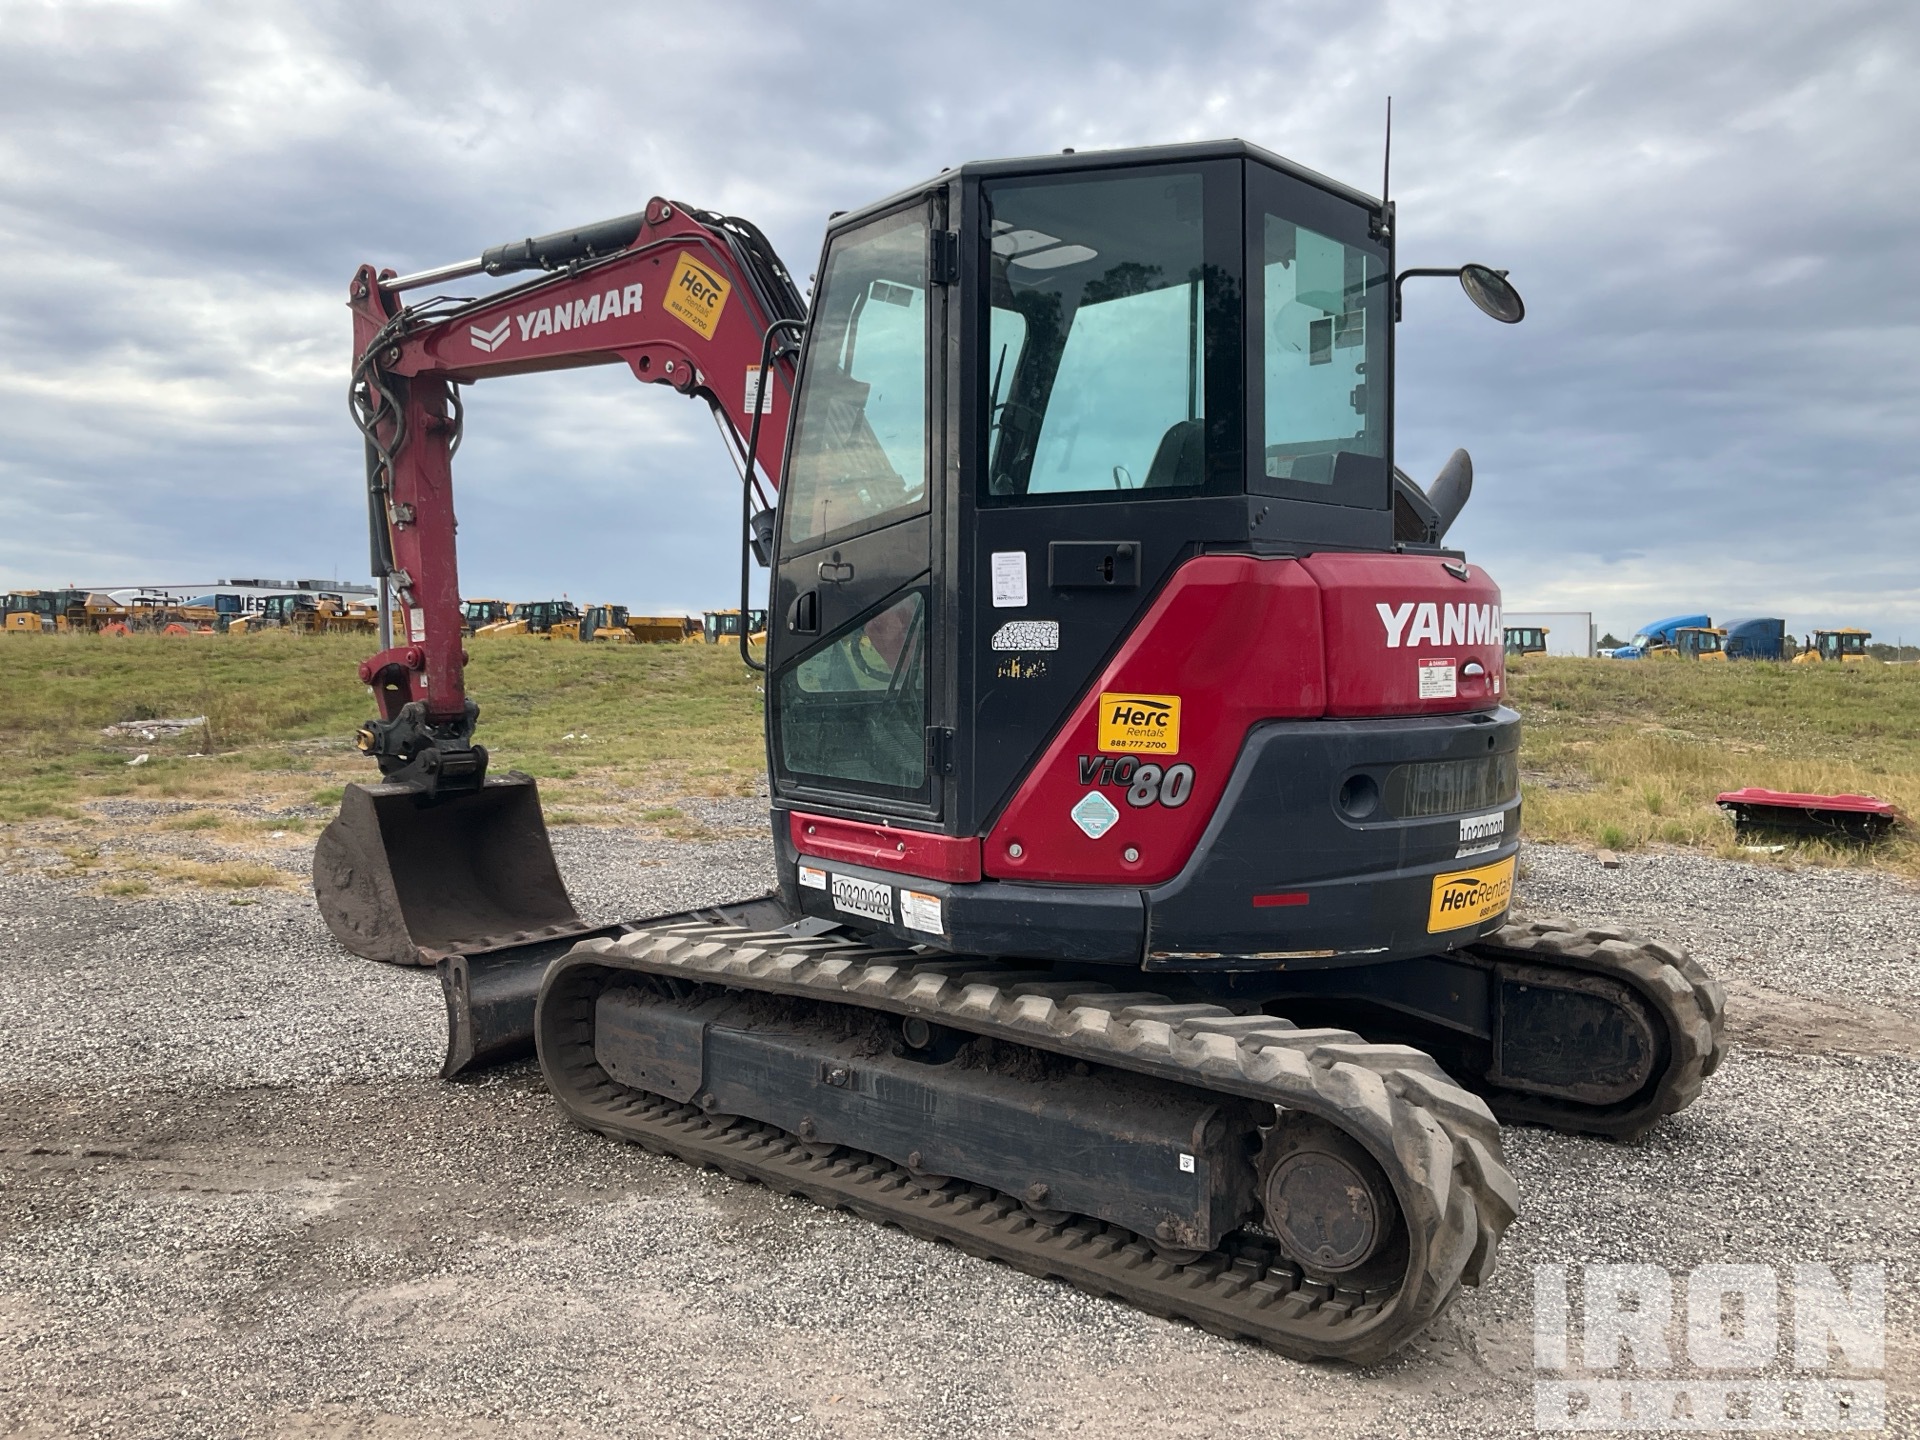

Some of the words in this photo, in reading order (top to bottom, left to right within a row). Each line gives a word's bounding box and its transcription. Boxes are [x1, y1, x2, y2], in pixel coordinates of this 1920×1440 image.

[679, 270, 719, 308] Herc
[516, 283, 643, 341] YANMAR
[685, 295, 710, 318] Rentals
[1376, 603, 1504, 648] YANMA
[1111, 706, 1170, 727] Herc
[1126, 727, 1165, 738] Rentals
[1110, 740, 1167, 749] 888-777-2700
